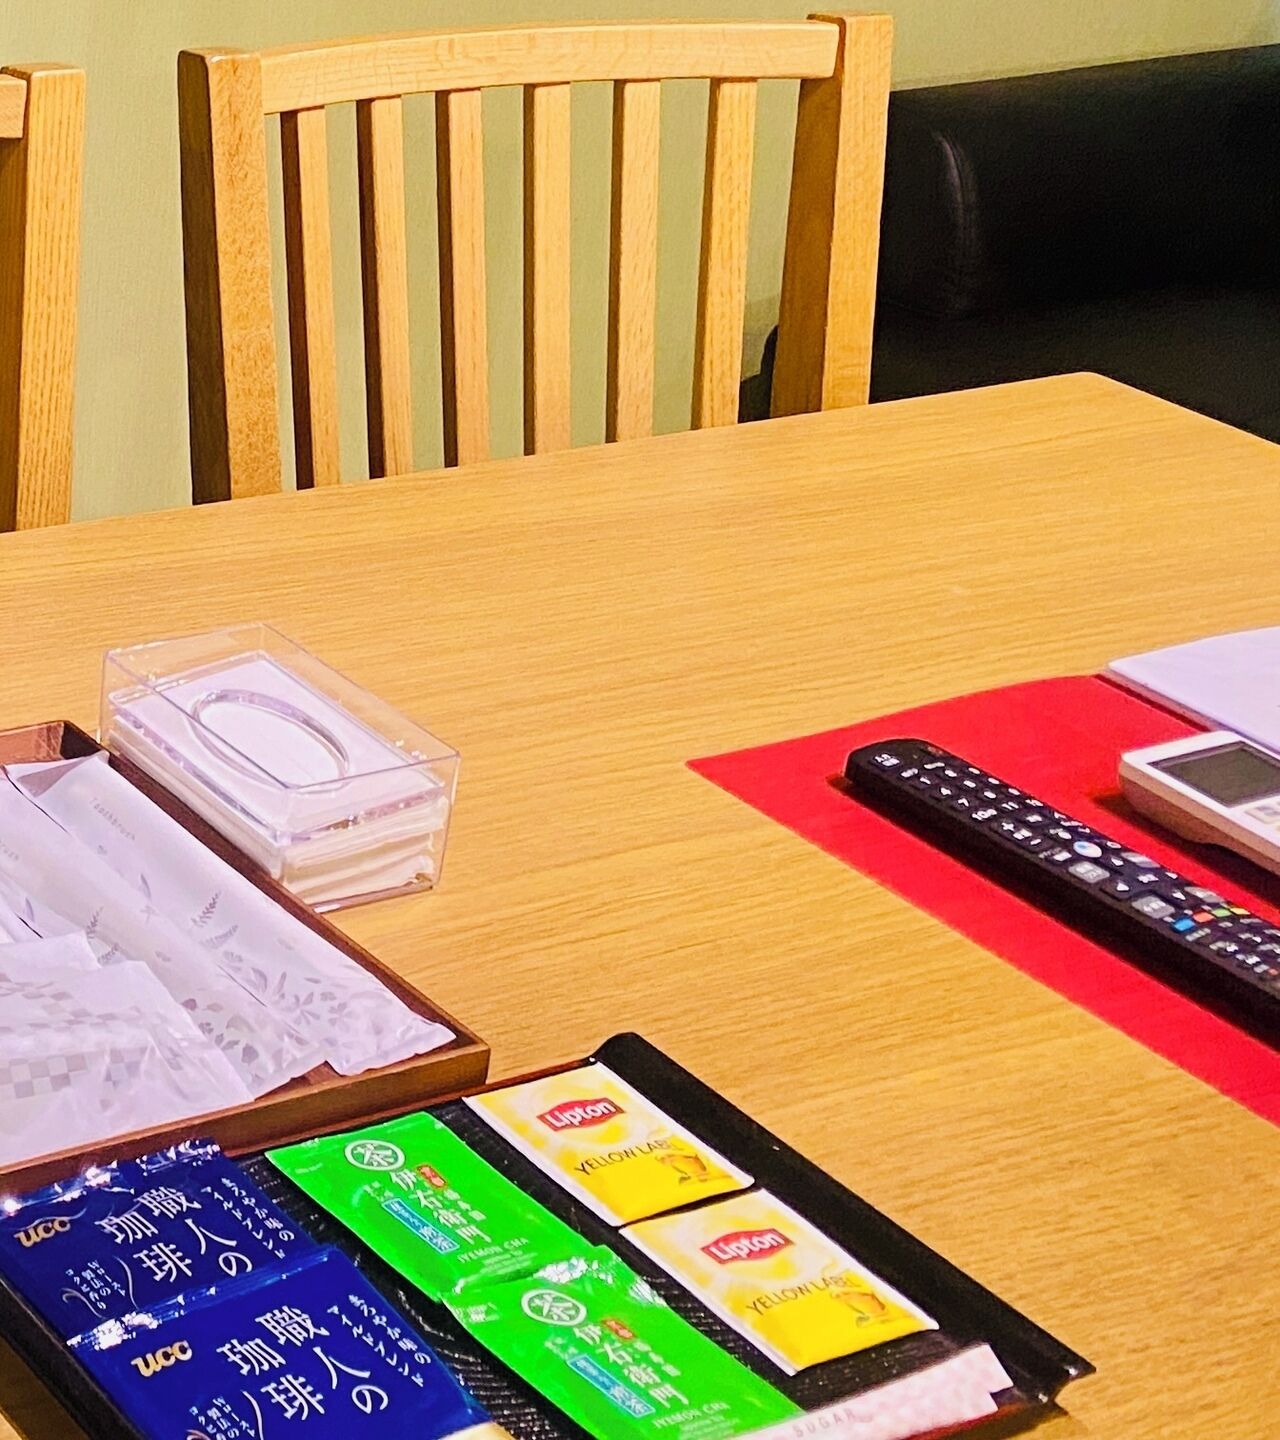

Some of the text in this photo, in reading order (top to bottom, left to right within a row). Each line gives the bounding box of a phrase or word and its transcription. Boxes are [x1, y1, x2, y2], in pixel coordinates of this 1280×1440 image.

[545, 1101, 617, 1127] Lipton
[351, 1143, 394, 1167] 茶
[574, 1147, 637, 1176] YELLOW
[133, 1186, 253, 1277] 職人の
[201, 1186, 286, 1259] マイルドブレンド
[221, 1177, 295, 1242] まろやか味の
[390, 1169, 492, 1245] 伊右衛門
[94, 1211, 192, 1283] 珈琲
[457, 1237, 529, 1263] IYEMON CHA
[708, 1232, 785, 1260] Lipton
[348, 1294, 431, 1364] まろやか味の
[530, 1293, 576, 1321] 茶
[746, 1283, 812, 1316] YELLOW
[216, 1338, 325, 1421] 珈琲
[254, 1305, 388, 1414] 職人の
[327, 1305, 424, 1387] マイルドブレンド
[573, 1324, 689, 1408] 伊右衛門
[792, 1408, 856, 1438] SUGAR
